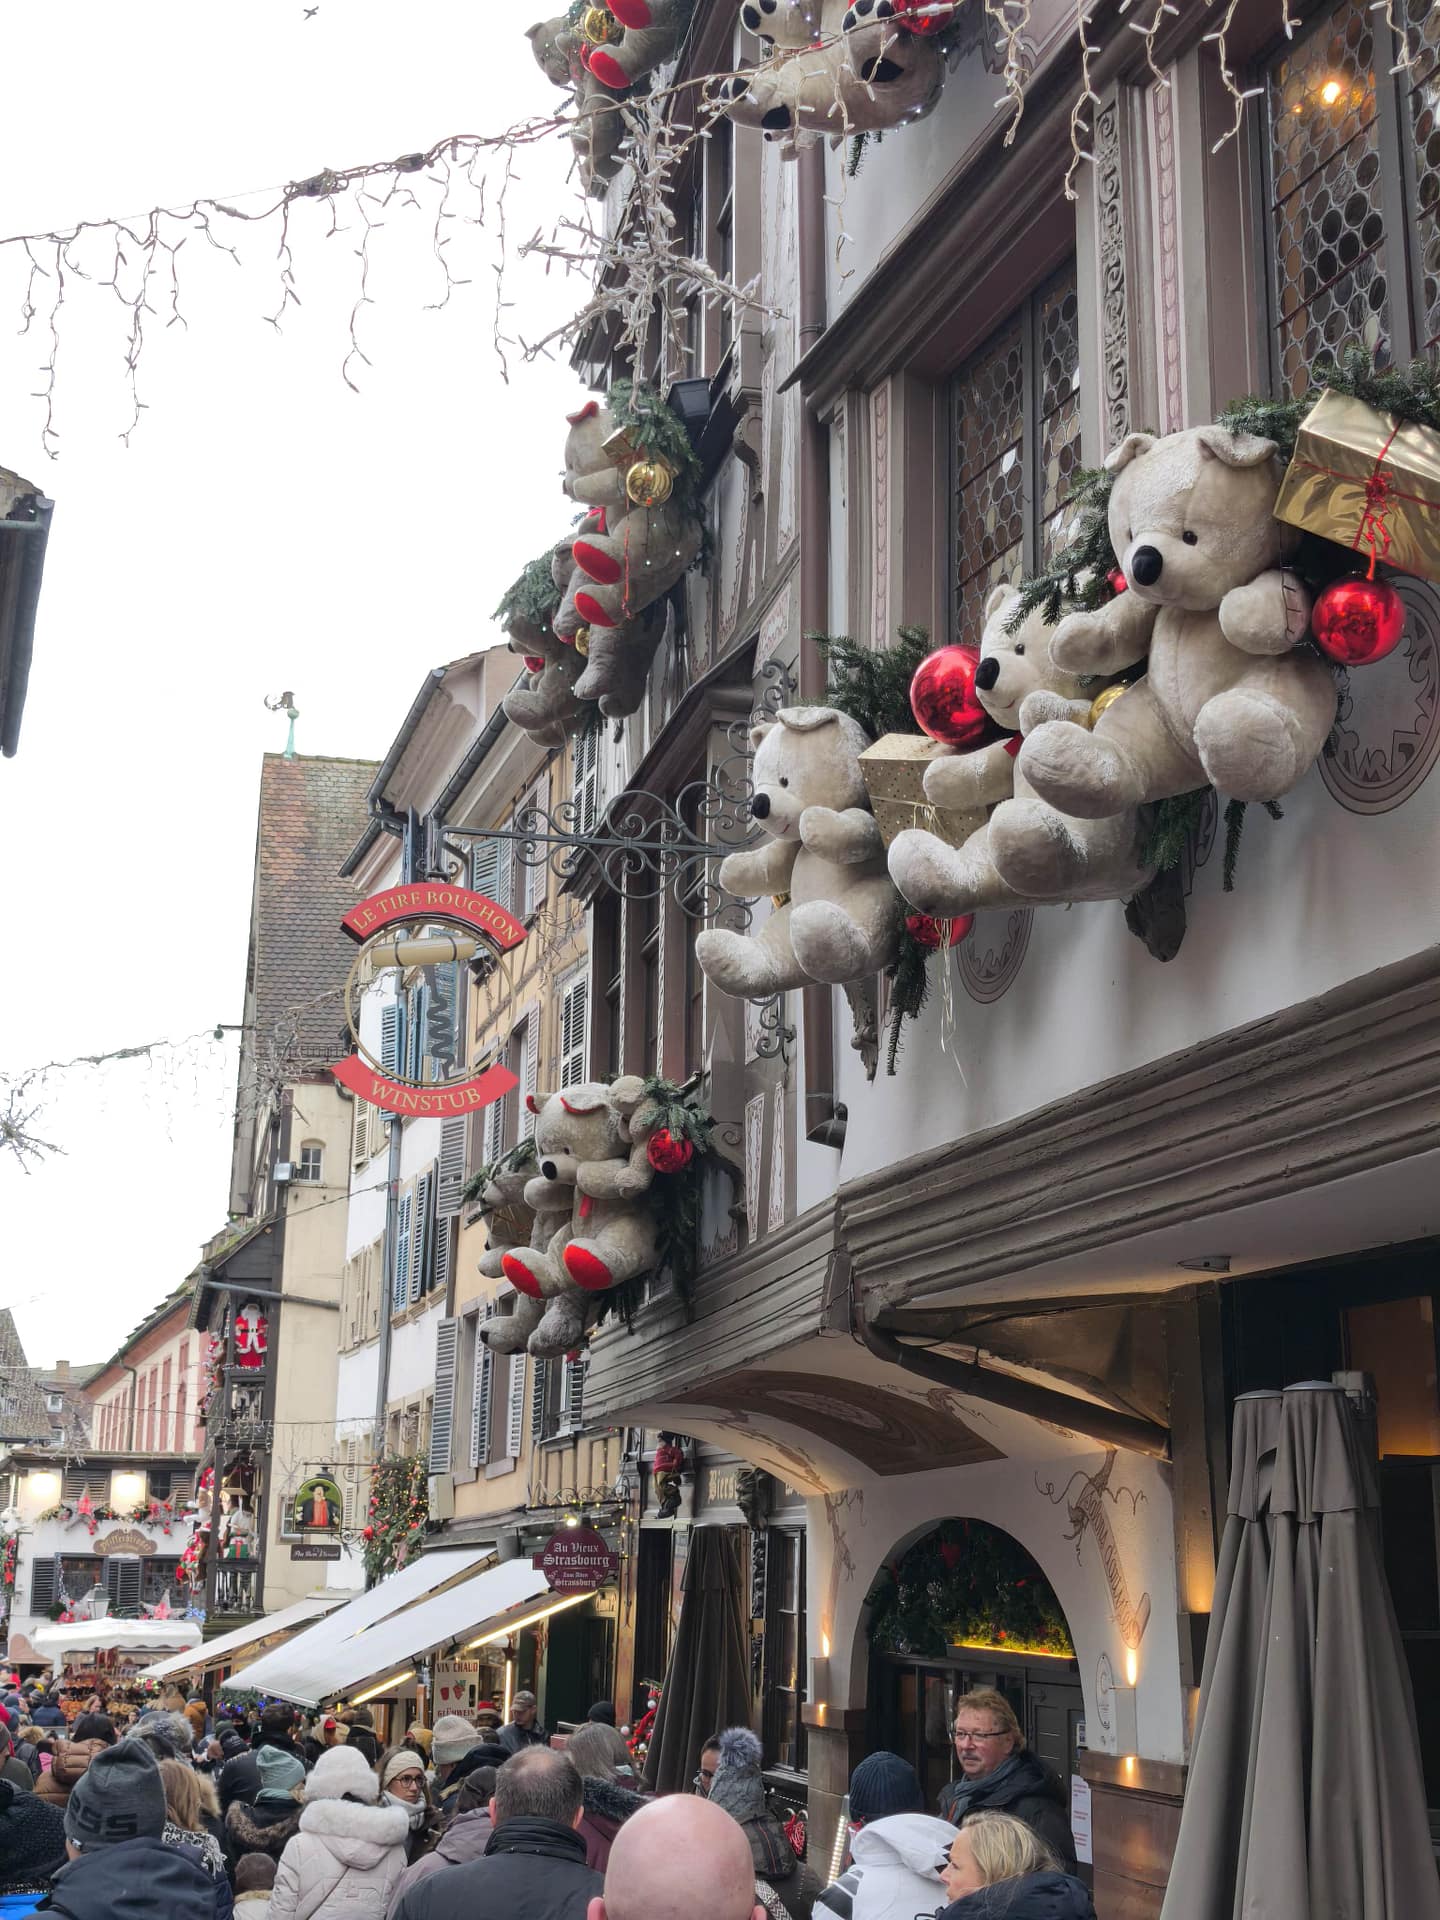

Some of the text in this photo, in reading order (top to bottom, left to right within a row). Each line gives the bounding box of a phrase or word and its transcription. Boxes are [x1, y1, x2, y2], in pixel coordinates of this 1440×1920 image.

[353, 891, 519, 943] LE TIRE BOUCHON
[371, 1080, 481, 1112] WINSTUB
[554, 1542, 599, 1552] Au Vieux
[543, 1554, 610, 1567] Strasbourg
[437, 1662, 477, 1672] VIN CHAUD
